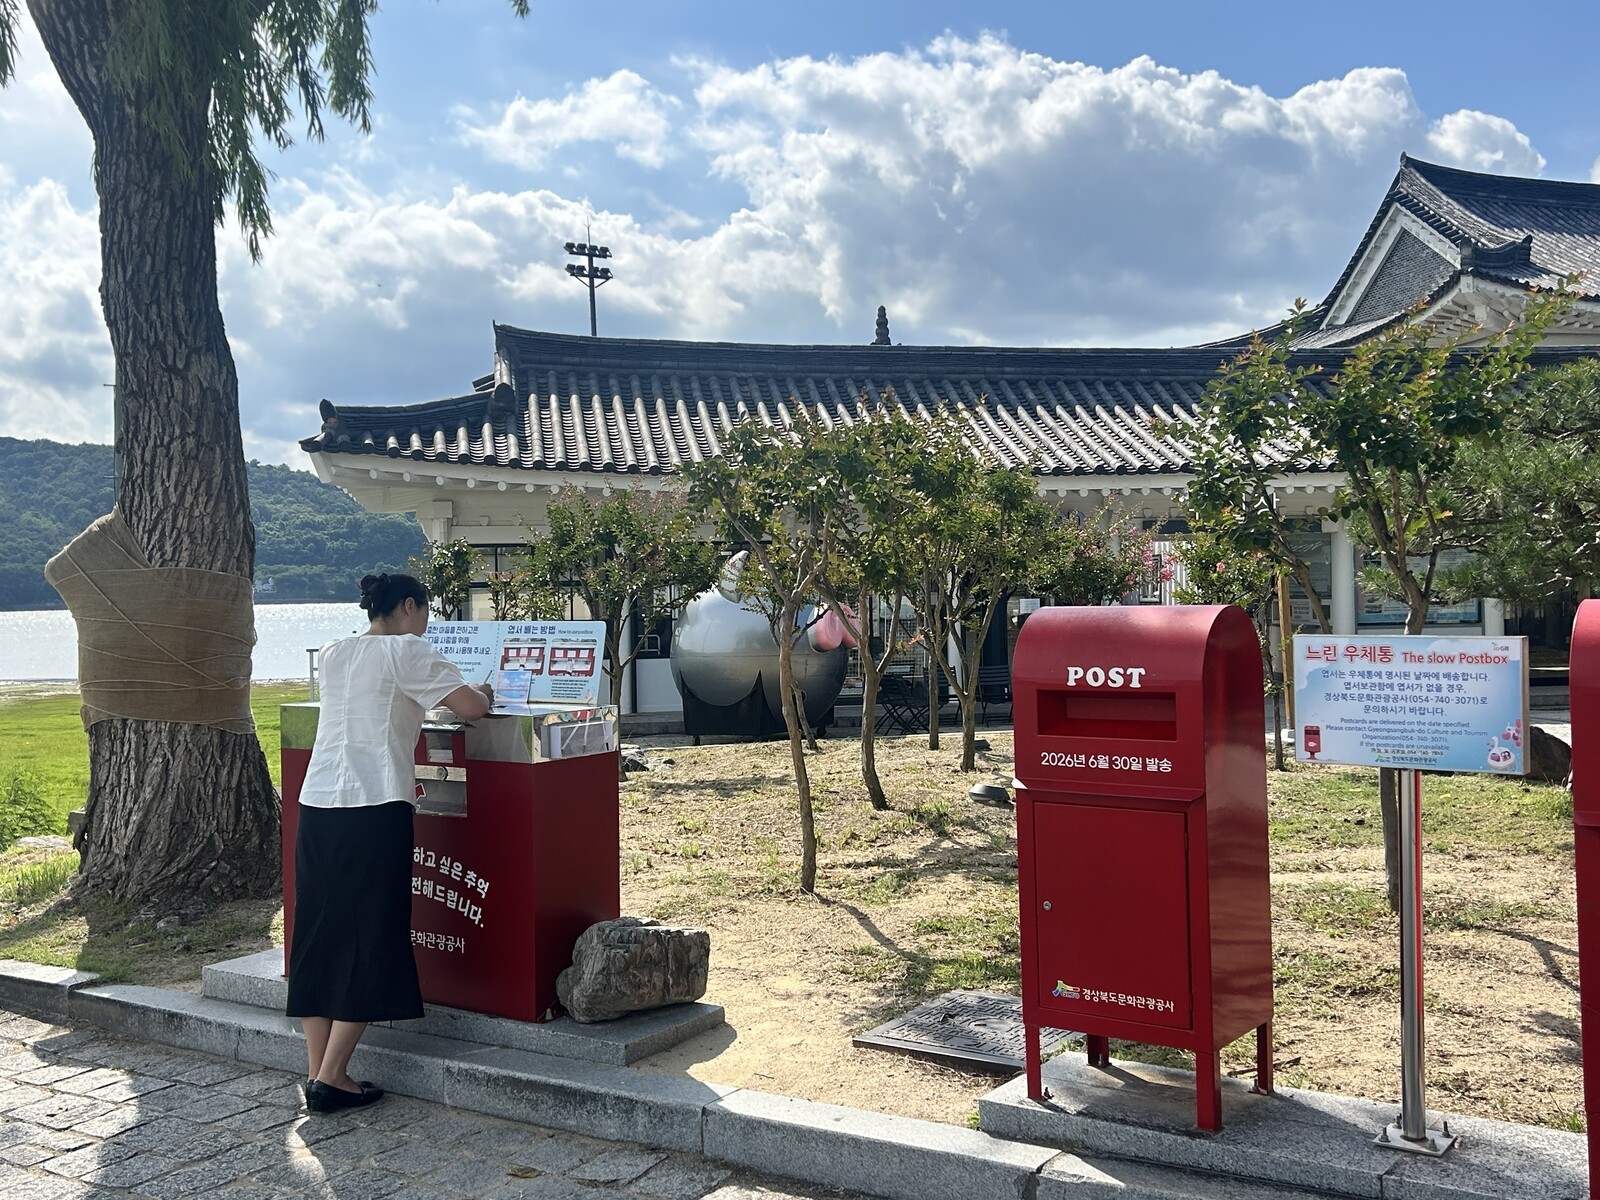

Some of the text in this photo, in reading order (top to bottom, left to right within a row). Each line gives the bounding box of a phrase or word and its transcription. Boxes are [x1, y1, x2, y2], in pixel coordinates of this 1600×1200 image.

[508, 626, 522, 634] 엽서
[540, 626, 556, 634] 방법
[1304, 645, 1394, 664] 느린 우체통
[1402, 652, 1508, 664] The slow Postbox
[1066, 666, 1146, 688] POST
[1322, 670, 1490, 682] 엽서는 우체통에 명시된 날짜에 배송합니다.
[1344, 681, 1466, 694] 엽서보관함에 엽서가 없을 경우,
[1324, 692, 1488, 706] 경상북도문화관광공사(054-740-3071)로
[1363, 704, 1446, 716] 문의하시기 바랍니다.
[1368, 726, 1426, 734] Gyeongsangbuk-do
[1040, 752, 1172, 773] 2026년 6월 30일 발송
[440, 856, 463, 882] 싶은
[464, 870, 490, 898] 추억
[412, 876, 484, 928] 전해드립니다.
[1082, 988, 1174, 1012] 경상북도문화관광공사
